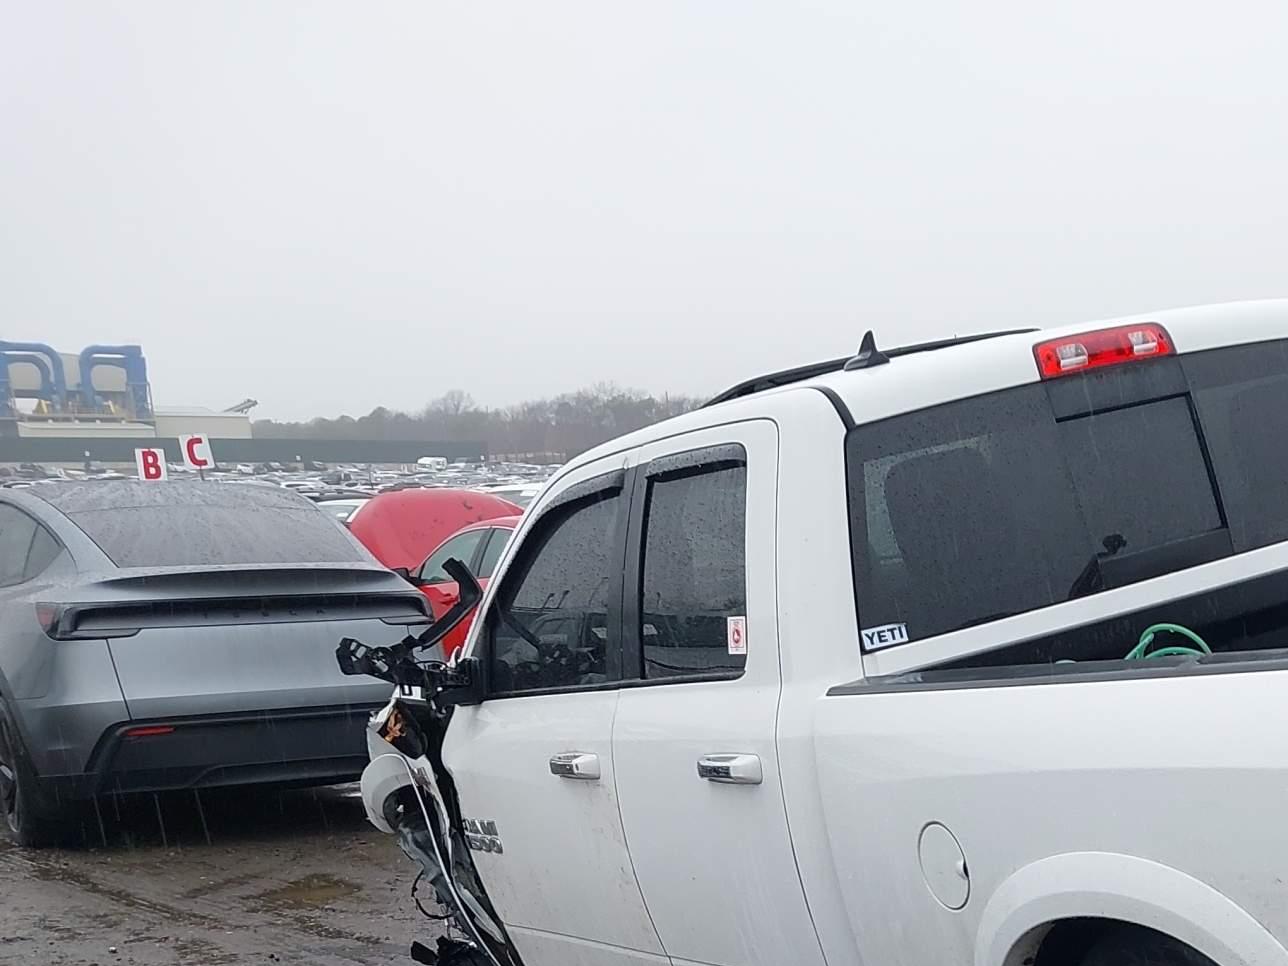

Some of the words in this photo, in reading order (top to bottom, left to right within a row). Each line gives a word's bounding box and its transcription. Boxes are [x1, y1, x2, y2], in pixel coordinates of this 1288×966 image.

[141, 448, 162, 480] B
[186, 437, 208, 467] C
[864, 625, 905, 646] YETI
